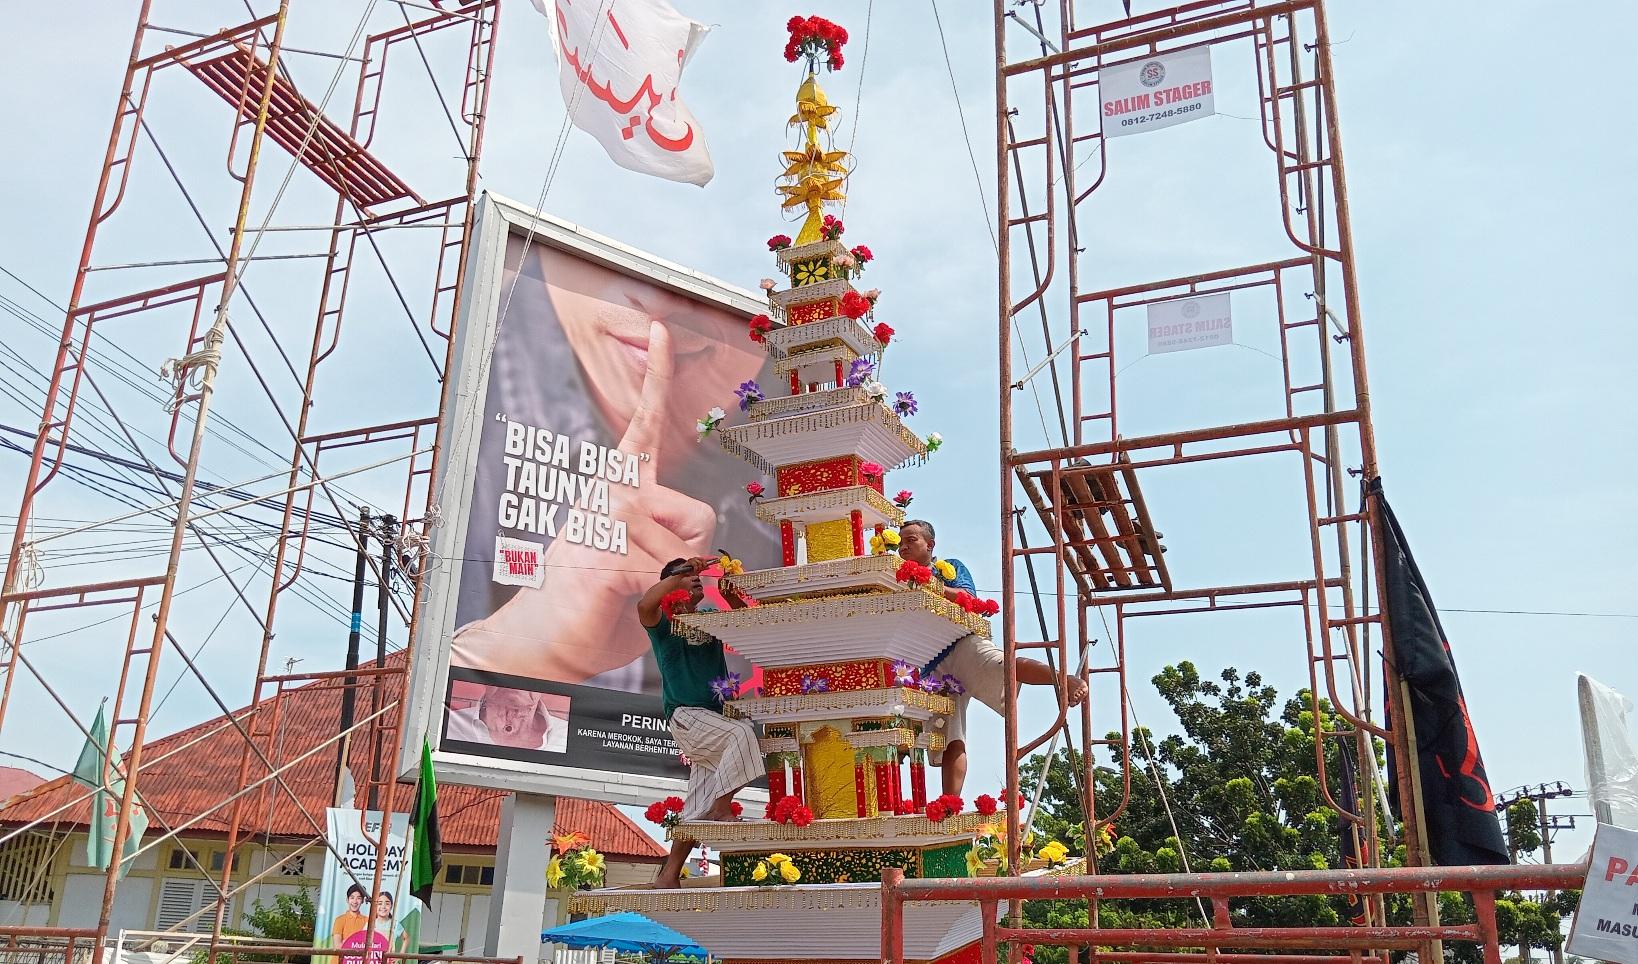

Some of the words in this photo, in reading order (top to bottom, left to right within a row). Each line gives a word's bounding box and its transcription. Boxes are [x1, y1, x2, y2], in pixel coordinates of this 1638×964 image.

[1104, 93, 1151, 117] SALIM
[1153, 80, 1212, 107] STAGER
[1121, 103, 1202, 127] 0812-7248-5880
[495, 412, 570, 470] “BISA
[579, 440, 650, 488] BISA”
[503, 456, 610, 515] TAUNYA
[498, 492, 559, 538] GAK
[566, 508, 628, 555] BISA
[621, 713, 672, 733] PERIN
[577, 728, 607, 739] KARENA
[607, 732, 643, 744] MEROKOK,
[645, 736, 662, 746] SAYA
[602, 739, 634, 750] LAYANAN
[635, 744, 668, 755] BERHENTI
[346, 843, 406, 858] HOLIAY
